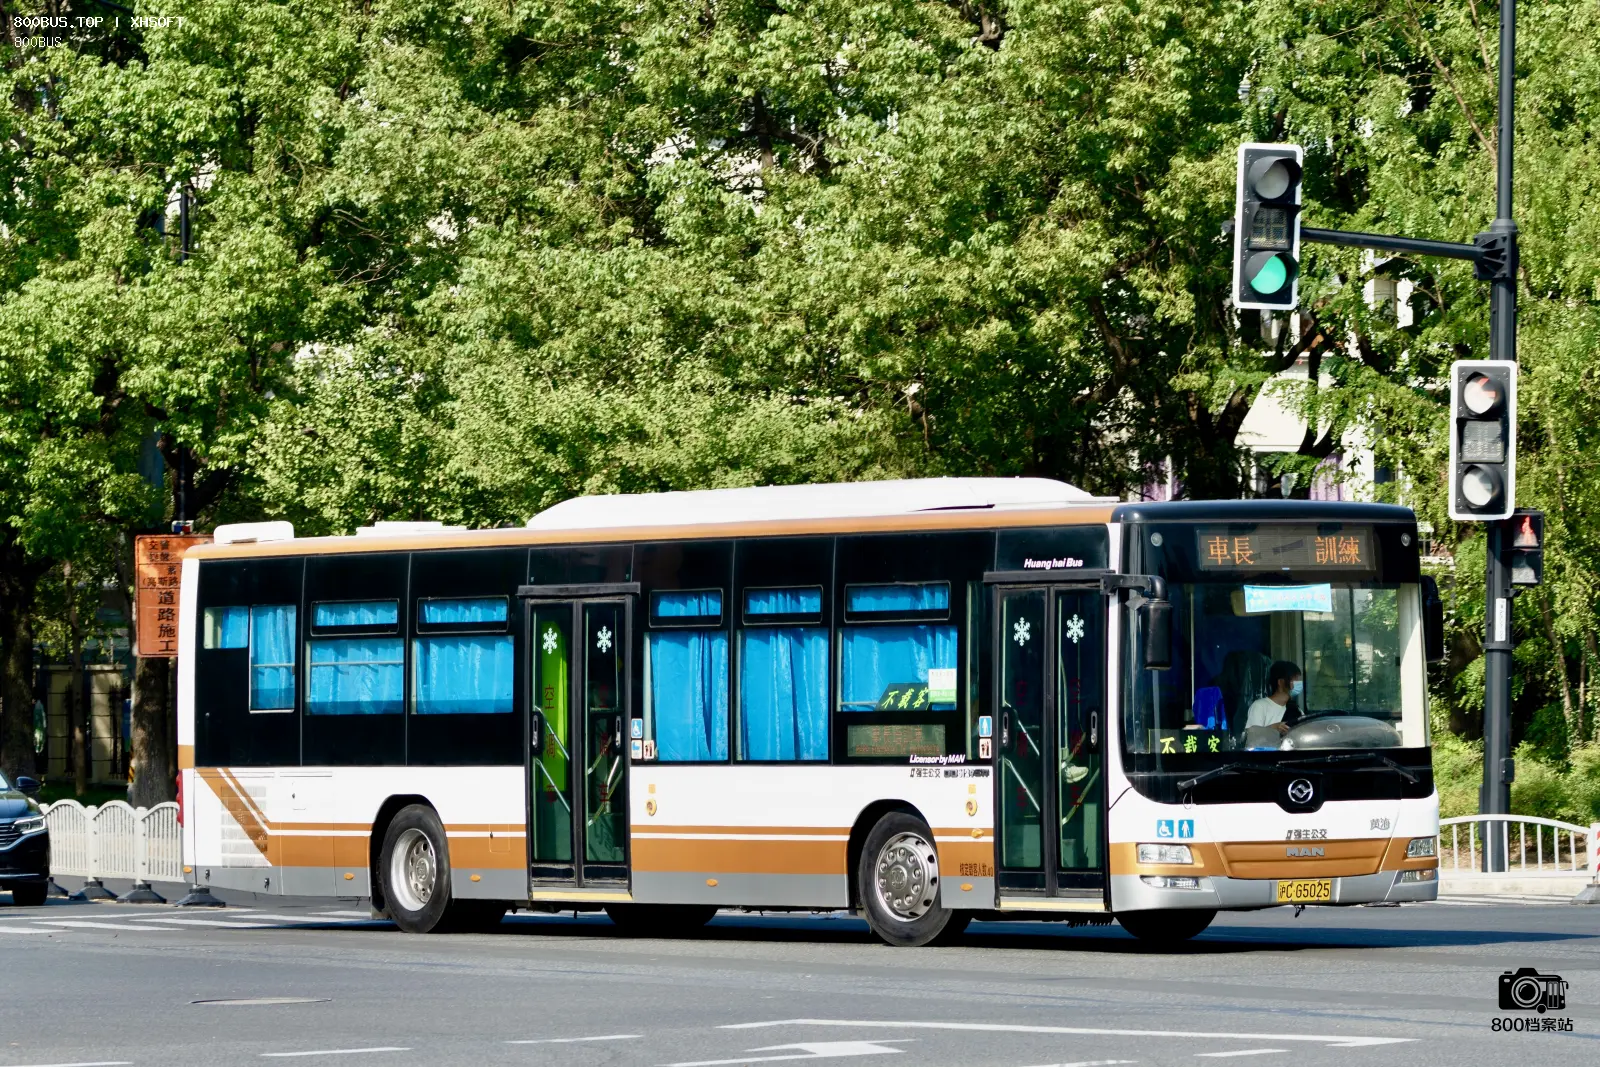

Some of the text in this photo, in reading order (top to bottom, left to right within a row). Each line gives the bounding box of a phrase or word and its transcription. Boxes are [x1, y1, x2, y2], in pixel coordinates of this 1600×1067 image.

[1207, 536, 1361, 565] 車長 訓練
[1066, 557, 1083, 567] Bus
[157, 590, 177, 652] 道路施工
[947, 755, 965, 763] MAN
[1294, 828, 1328, 839] 强生公交
[1286, 847, 1325, 857] MAN
